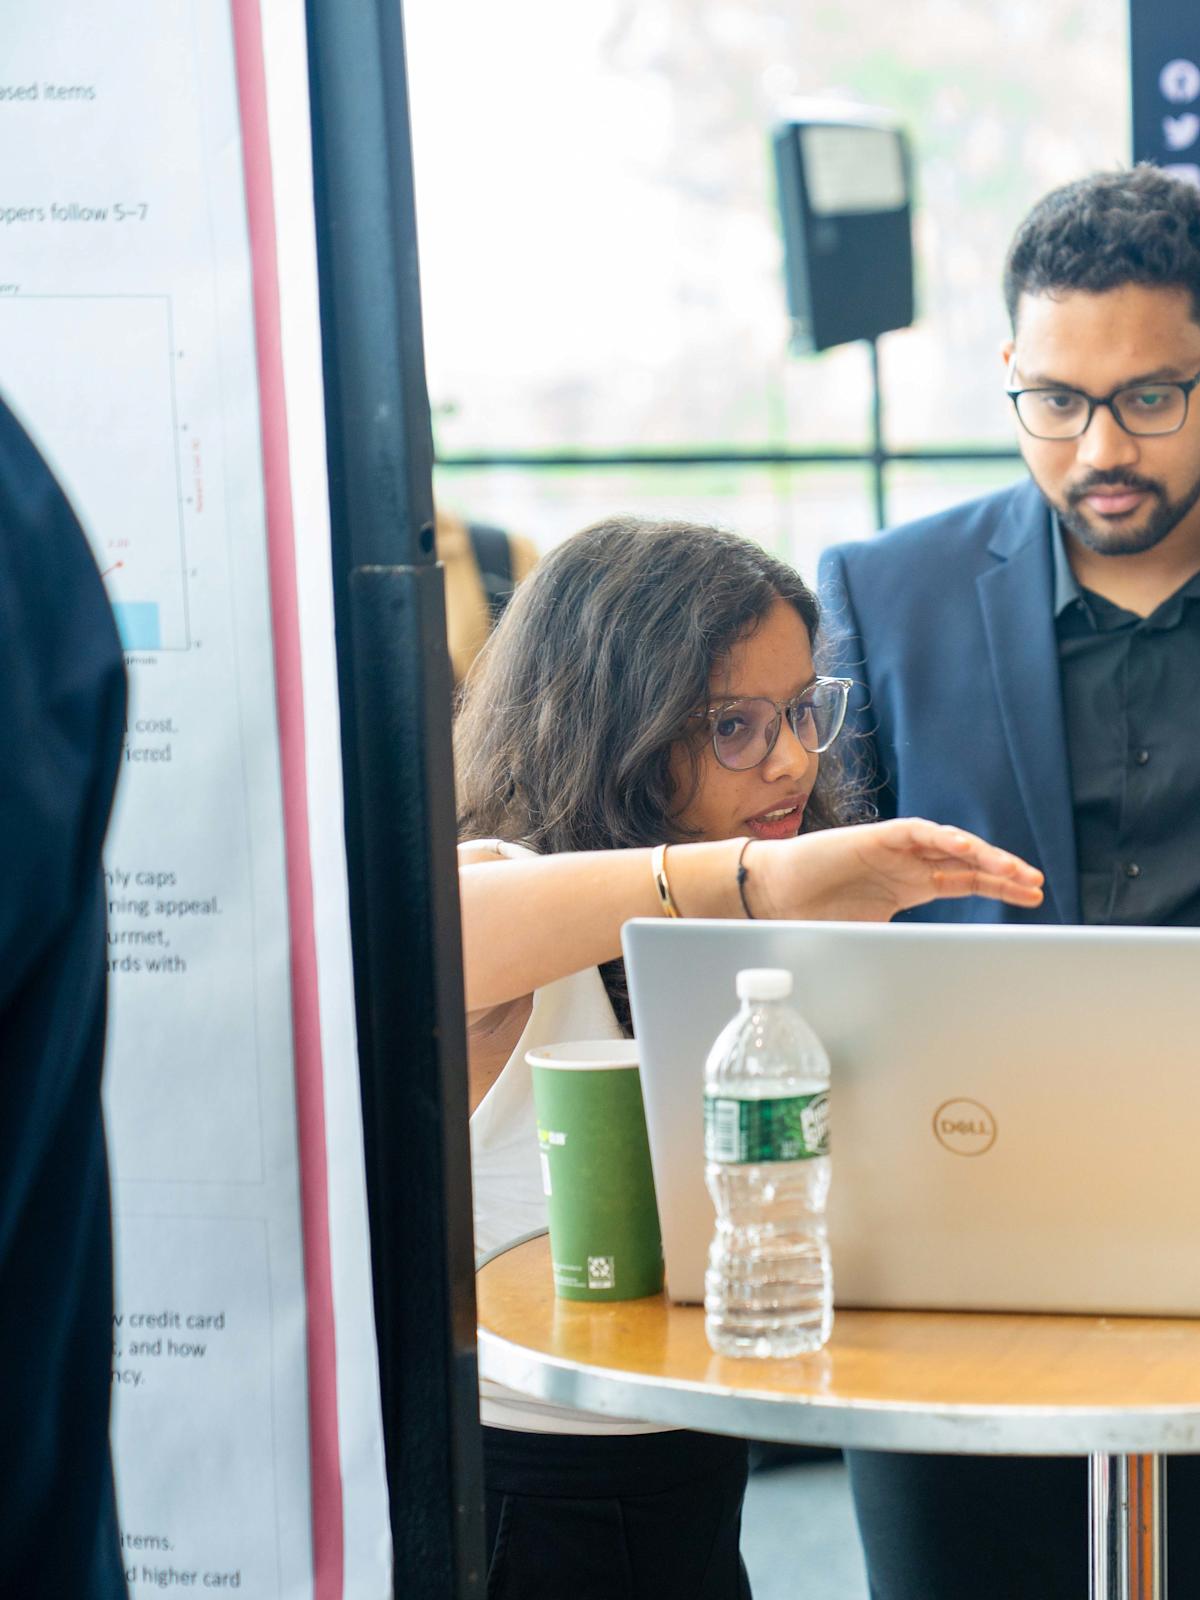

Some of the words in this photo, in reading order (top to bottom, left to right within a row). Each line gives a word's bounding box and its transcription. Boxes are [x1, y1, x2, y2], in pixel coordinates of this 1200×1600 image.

[44, 82, 97, 101] items
[51, 201, 108, 221] follow
[135, 718, 179, 734] cost.
[135, 872, 177, 889] caps
[154, 897, 223, 917] appeal.
[146, 955, 187, 973] with
[941, 1119, 989, 1136] DELL
[129, 1311, 180, 1330] credit
[185, 1312, 226, 1331] card
[129, 1339, 161, 1357] and
[167, 1340, 207, 1358] how
[142, 1566, 197, 1589] higher
[203, 1569, 241, 1589] card
